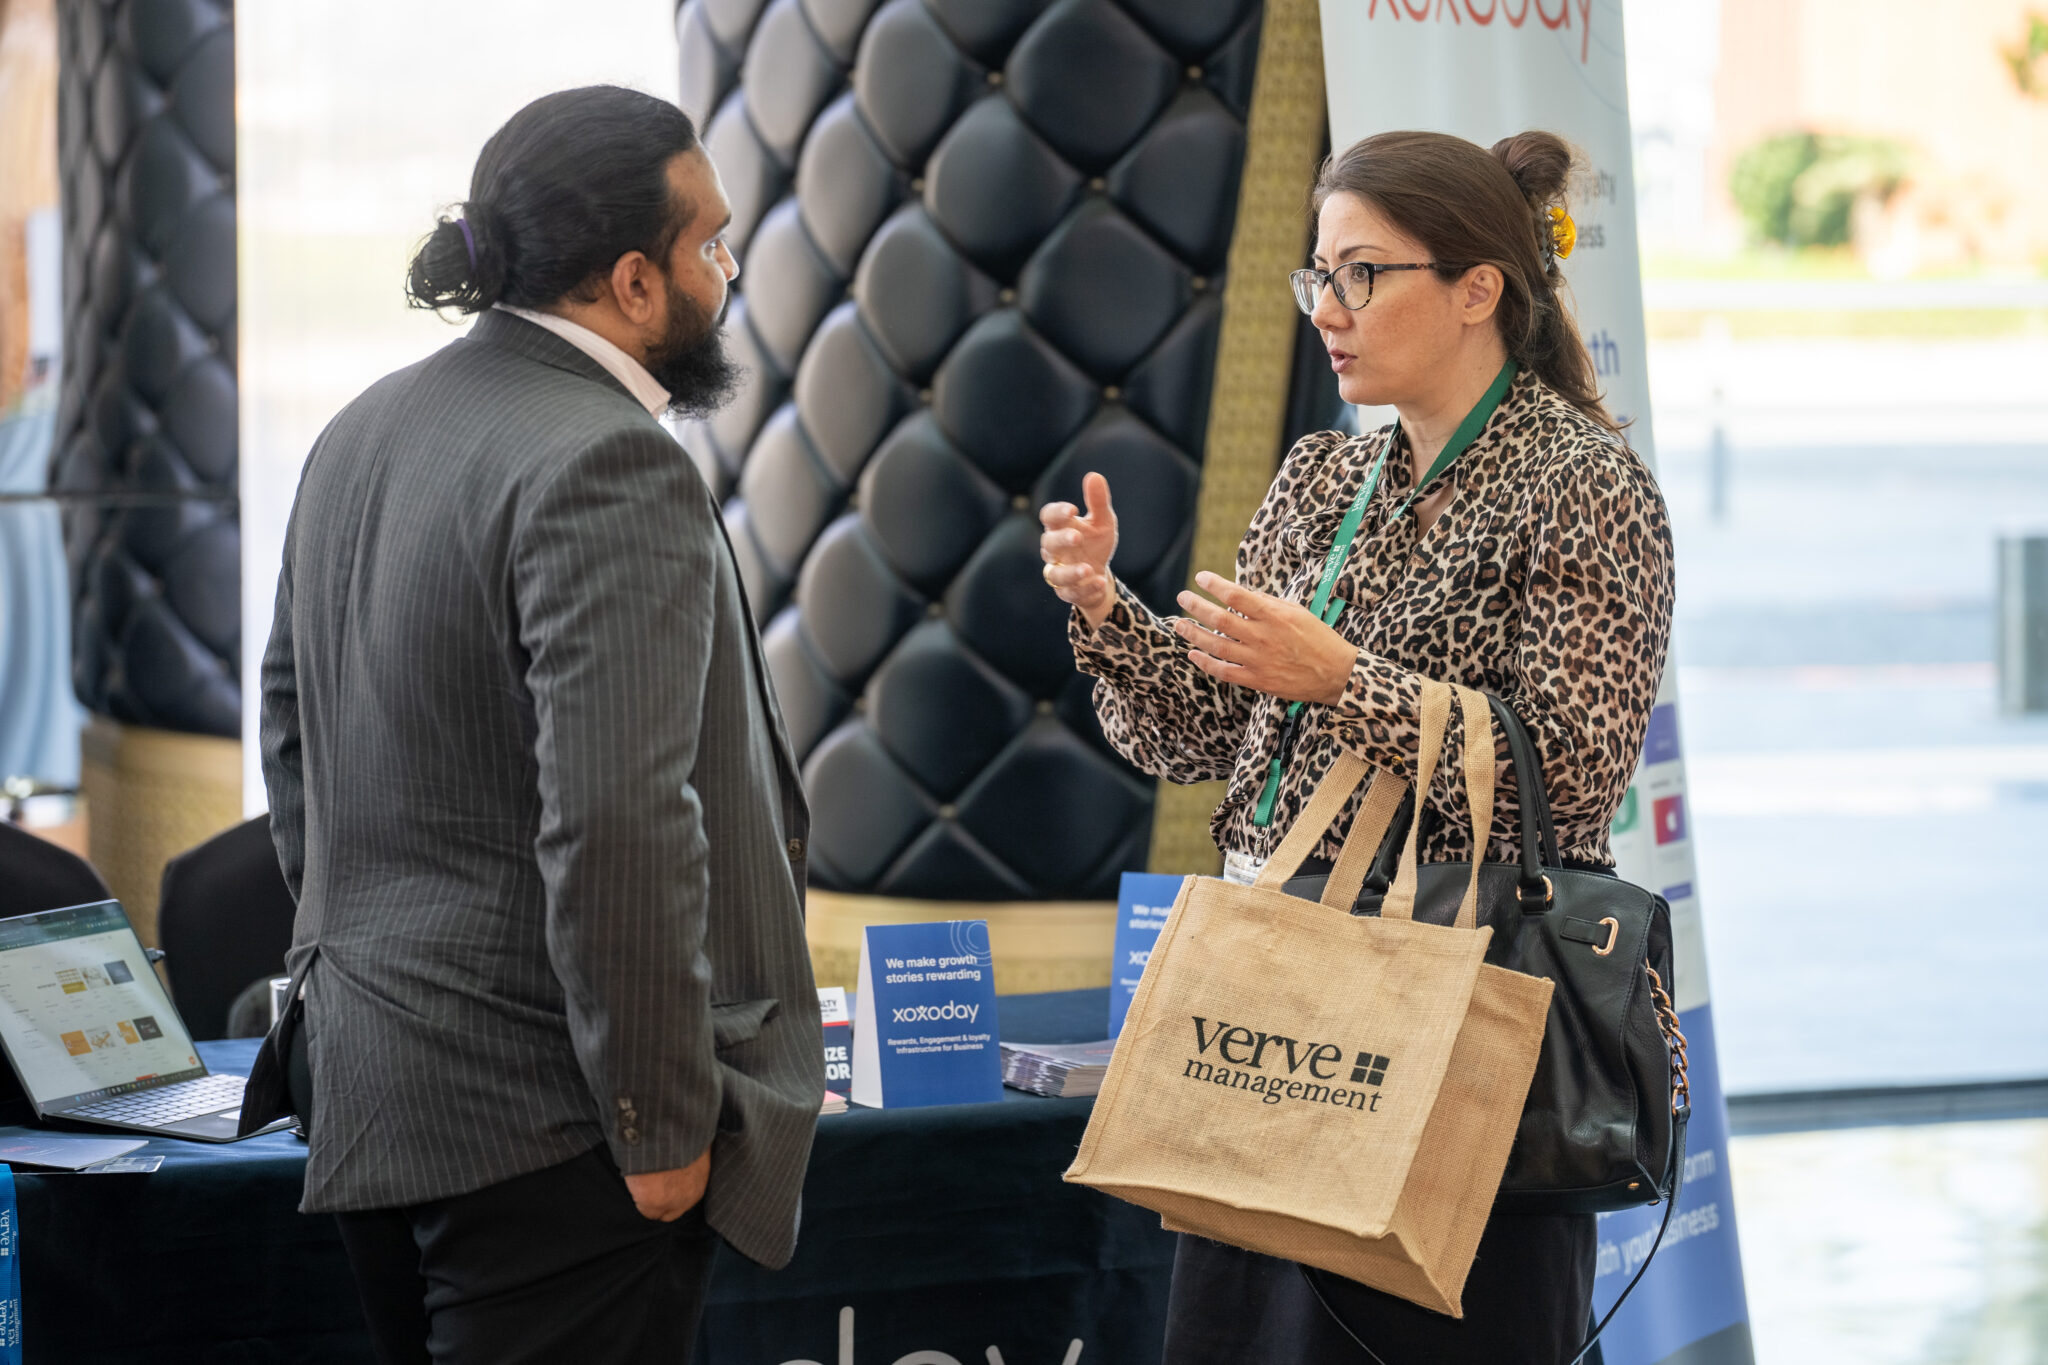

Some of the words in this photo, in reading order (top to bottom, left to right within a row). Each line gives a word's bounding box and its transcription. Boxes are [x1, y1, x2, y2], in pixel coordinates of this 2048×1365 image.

[1321, 552, 1339, 585] verve
[885, 957, 904, 969] We
[906, 956, 937, 968] make
[938, 954, 978, 969] growth
[886, 972, 924, 984] stories
[926, 969, 981, 982] rewarding
[892, 1000, 979, 1024] xoxoday
[896, 1045, 942, 1055] Infrastructure
[942, 1044, 953, 1052] for
[953, 1043, 984, 1051] Business
[919, 1035, 961, 1046] Engagement
[1191, 1016, 1342, 1080] verve
[1182, 1058, 1383, 1113] management
[1, 1209, 10, 1246] verve
